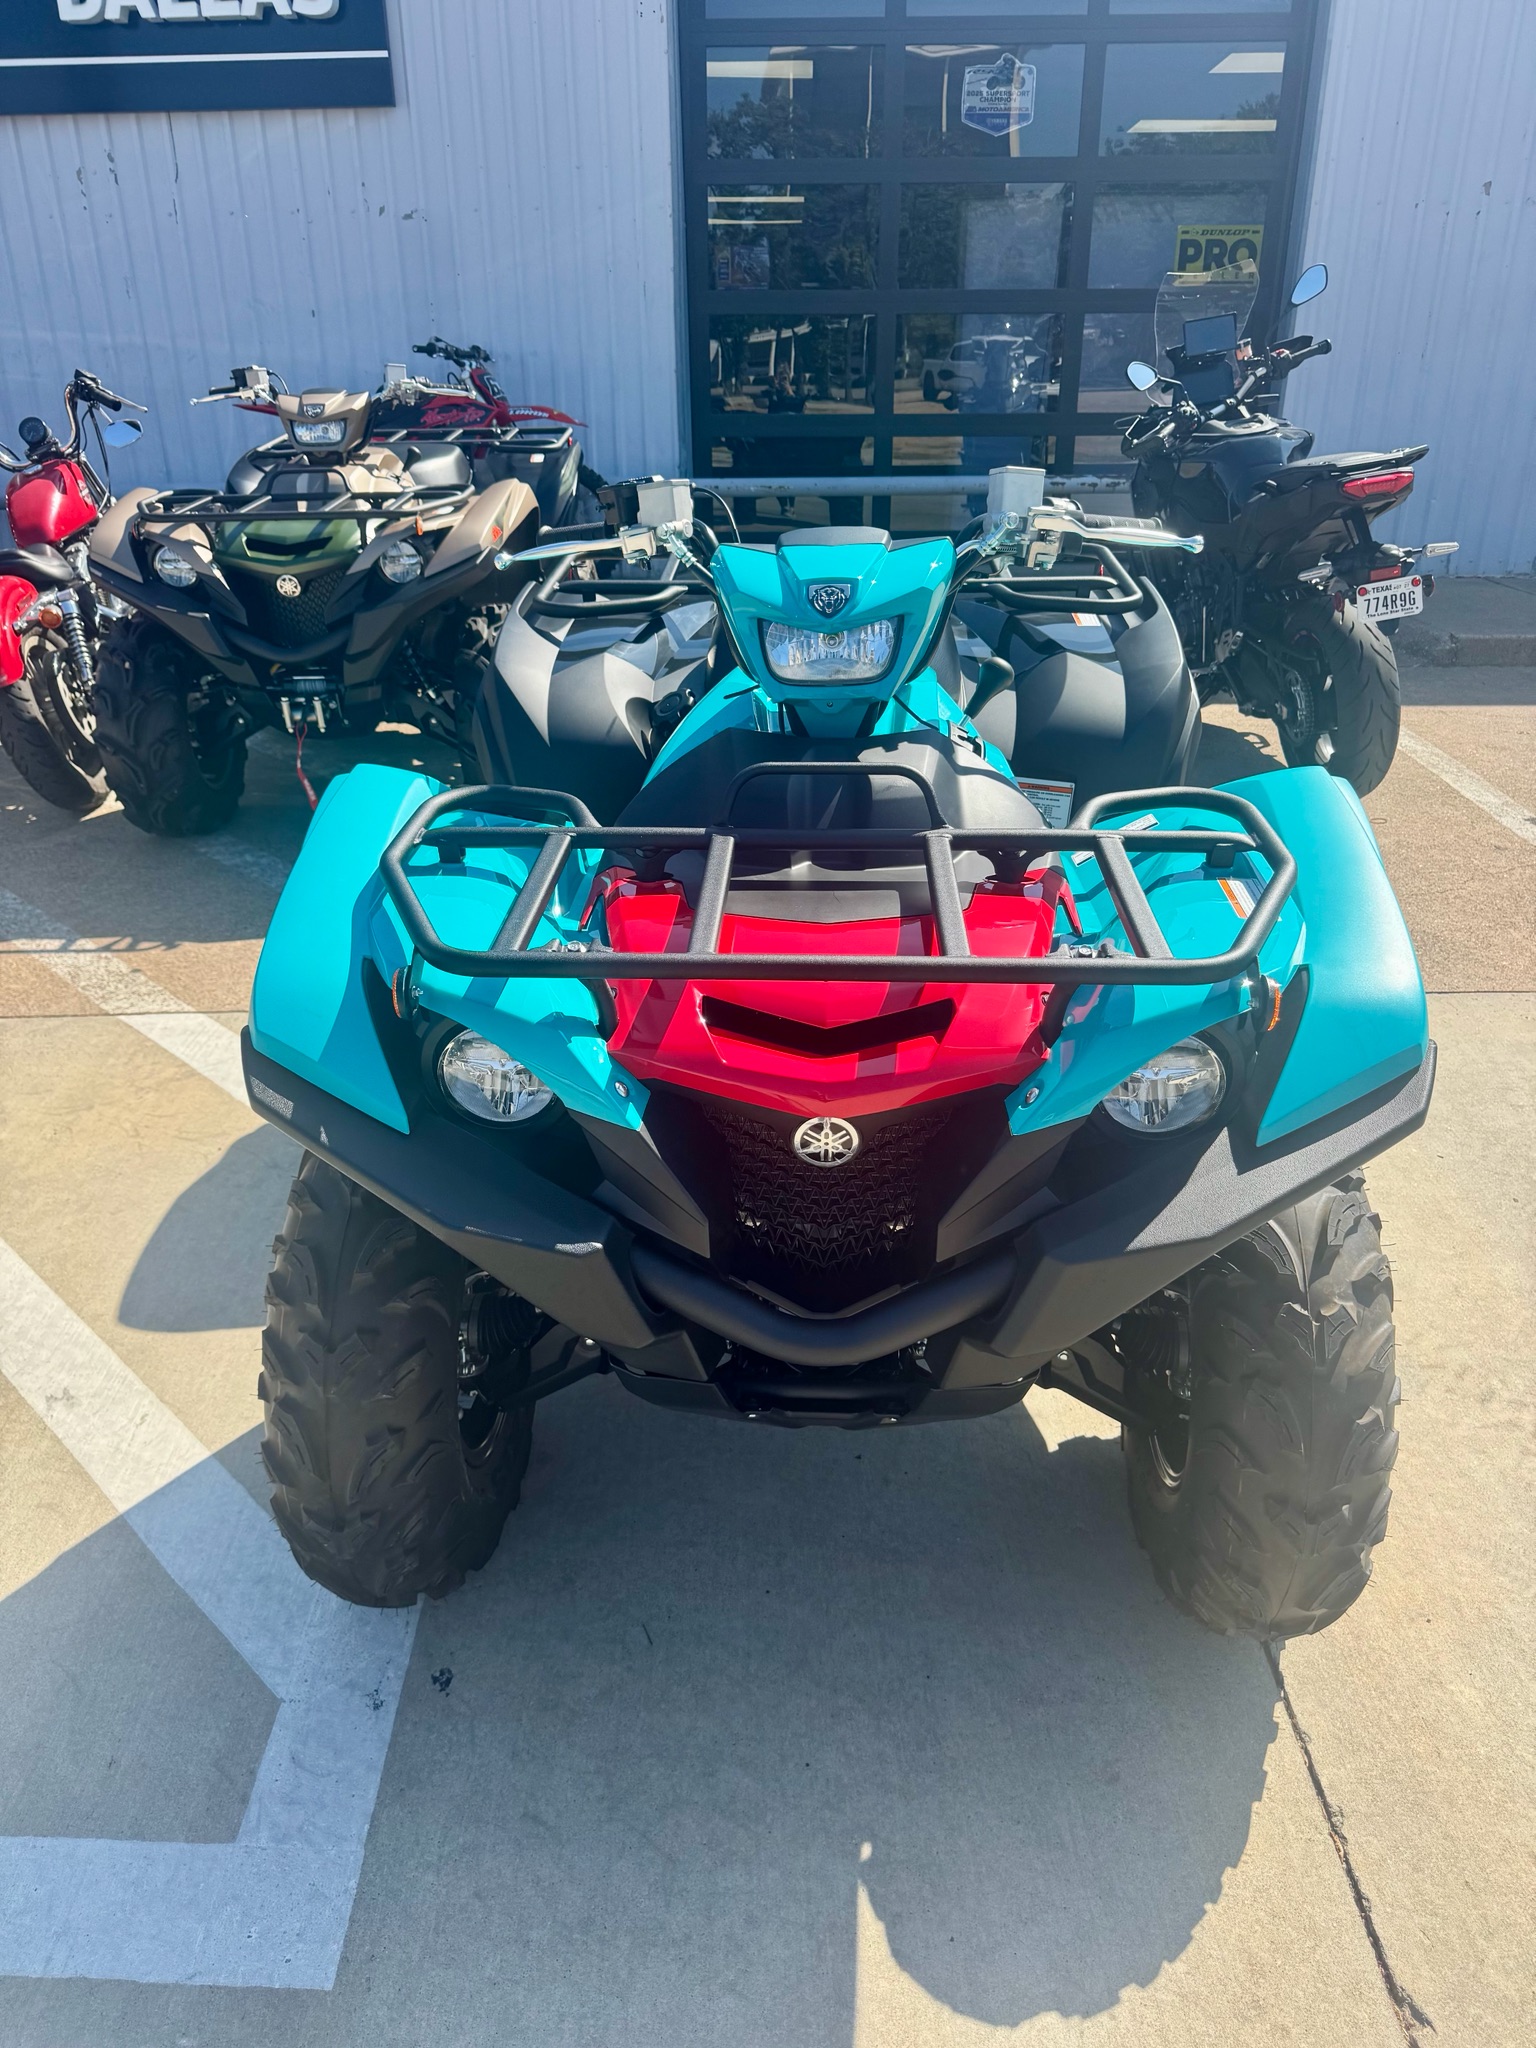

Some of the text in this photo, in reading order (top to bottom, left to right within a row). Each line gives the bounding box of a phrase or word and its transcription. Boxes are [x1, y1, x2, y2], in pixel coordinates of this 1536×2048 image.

[1177, 237, 1258, 272] PRO
[1178, 271, 1255, 280] DELER
[1364, 590, 1416, 614] 774R9G
